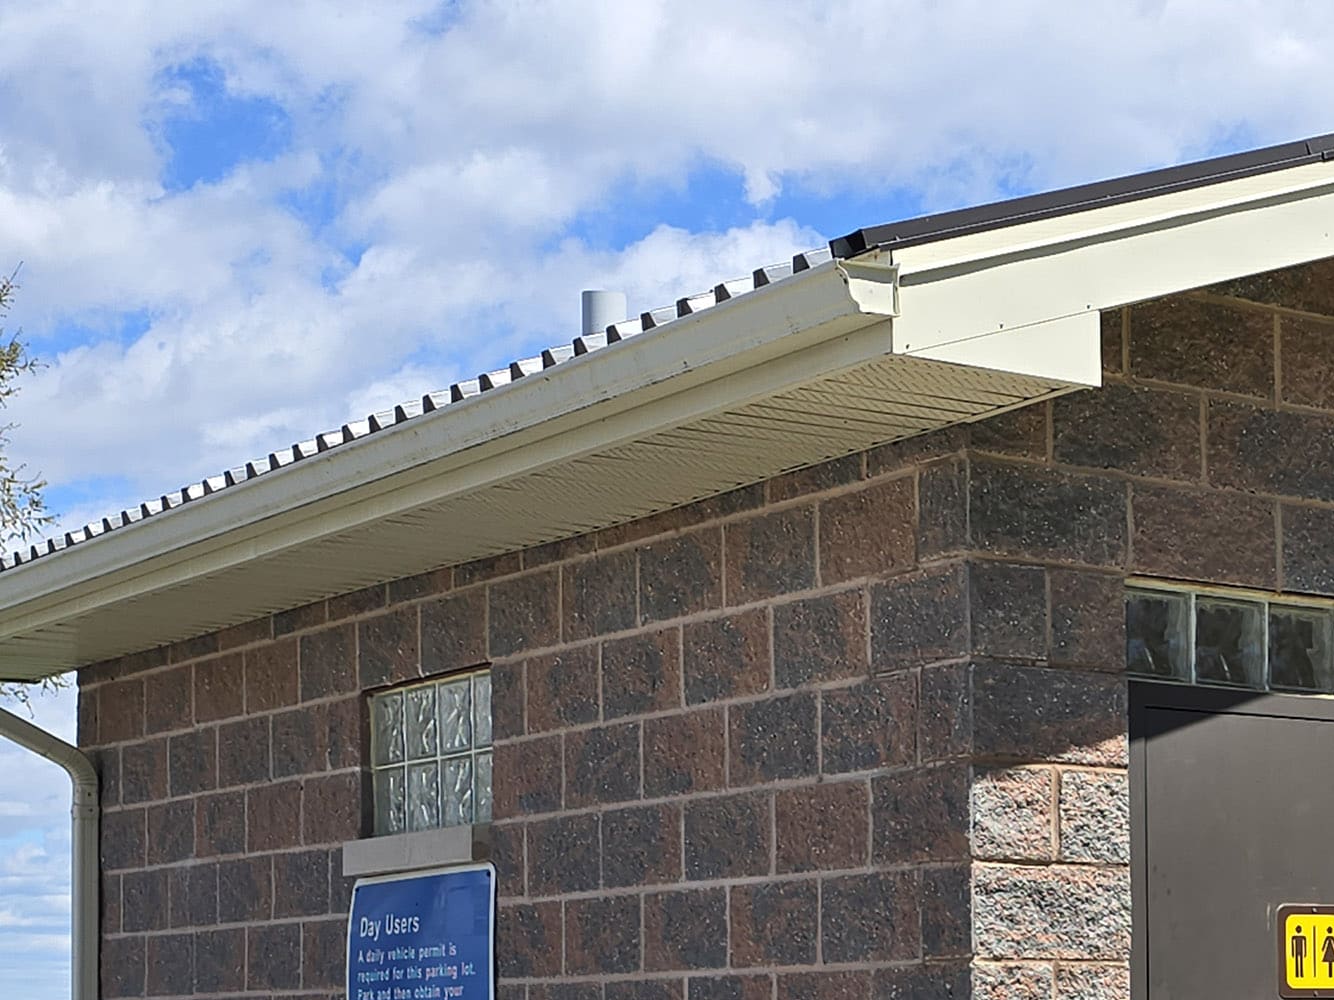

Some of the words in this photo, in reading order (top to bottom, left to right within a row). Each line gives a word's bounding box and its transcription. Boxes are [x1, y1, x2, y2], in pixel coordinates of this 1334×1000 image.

[360, 917, 381, 941] Day
[386, 914, 419, 935] Users
[358, 950, 364, 963] A
[366, 949, 384, 964] daily
[388, 946, 415, 960] vehicle
[419, 944, 445, 960] permit
[449, 942, 456, 955] is
[358, 969, 389, 985] required
[393, 968, 404, 980] for
[407, 966, 422, 979] this
[426, 963, 457, 980] parking
[462, 962, 476, 976] lot.
[358, 989, 374, 1000] Park
[377, 987, 390, 1000] and
[394, 987, 411, 999] then
[415, 985, 440, 998] obtain
[444, 985, 463, 1000] your
